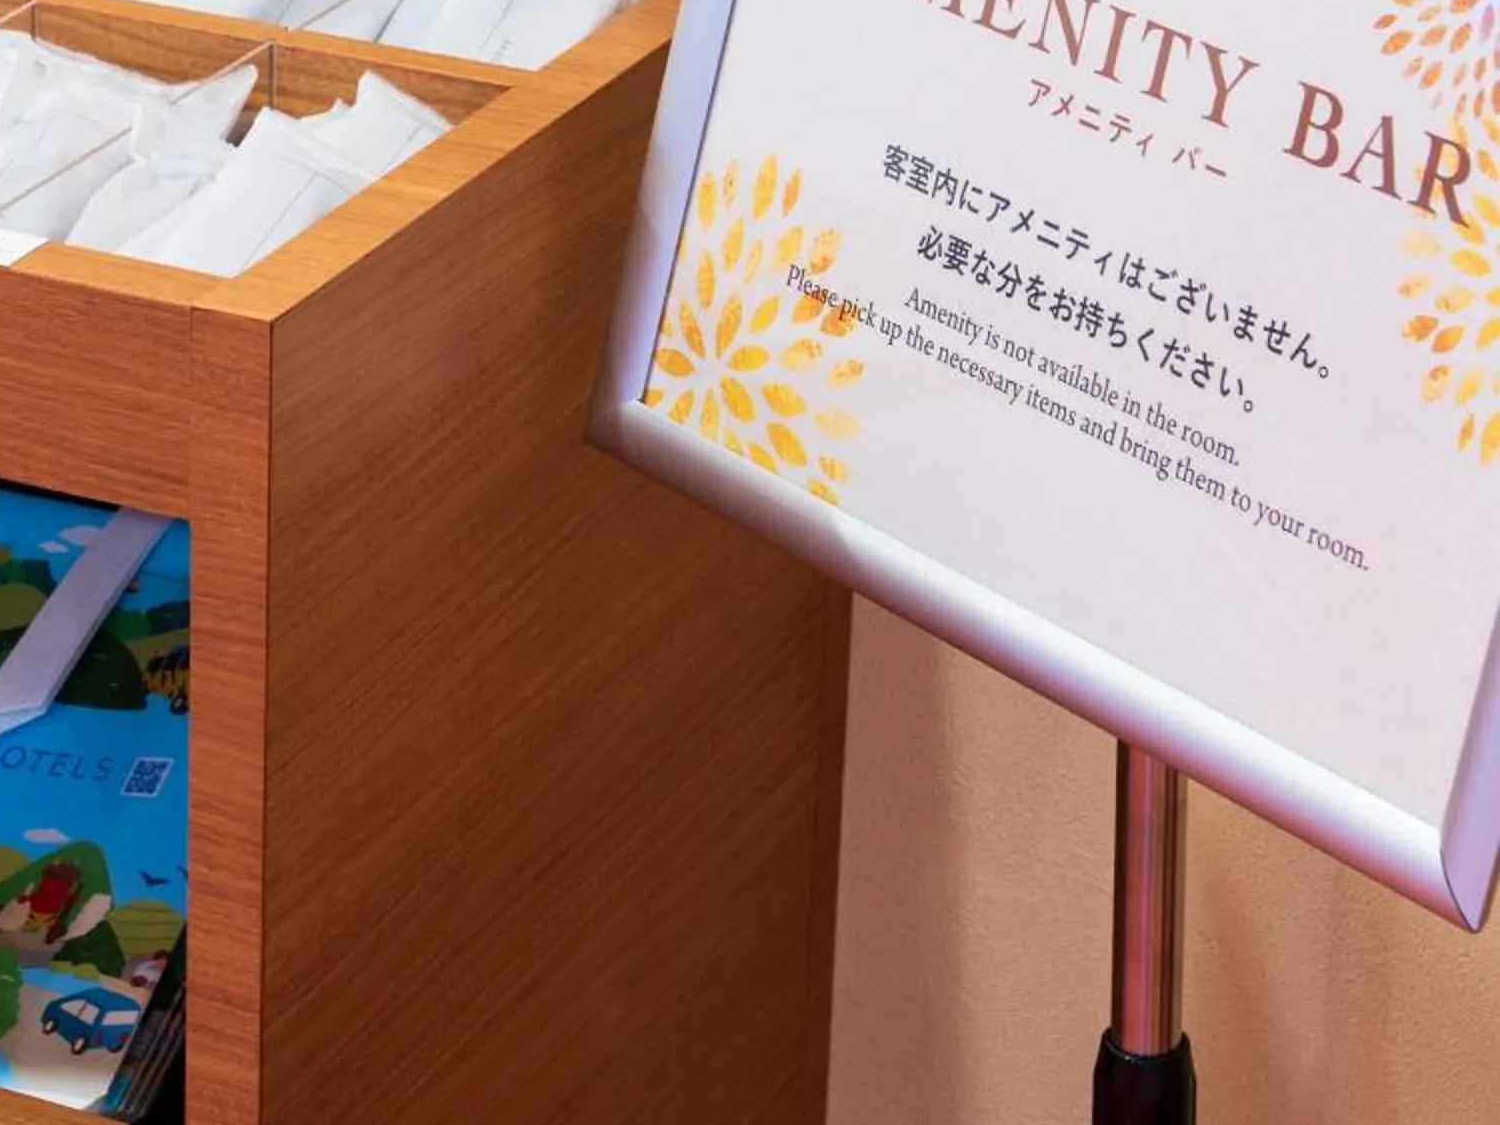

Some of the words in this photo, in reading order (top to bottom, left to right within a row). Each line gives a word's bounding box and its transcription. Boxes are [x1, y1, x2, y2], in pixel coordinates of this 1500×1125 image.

[1282, 80, 1472, 229] BAR
[882, 143, 1330, 380] 客室内にアメニティはございません。
[917, 225, 1255, 414] 必要な分をお持ちください。
[786, 263, 839, 308] Please
[839, 297, 881, 328] pick
[879, 315, 904, 346] up
[905, 324, 936, 356] the
[937, 349, 1025, 406] necessary
[1025, 385, 1078, 427] items
[1079, 415, 1118, 446] and
[1119, 426, 1173, 482] bring
[1174, 456, 1226, 502] them
[1230, 485, 1252, 513] to
[1254, 501, 1305, 539] your
[1306, 525, 1370, 572] room.
[903, 287, 984, 347] Amenity
[985, 323, 1001, 351] is
[1003, 336, 1036, 365] not
[1037, 355, 1119, 407] available
[1121, 390, 1141, 420] in
[1145, 402, 1178, 436] the
[1181, 424, 1240, 467] room.
